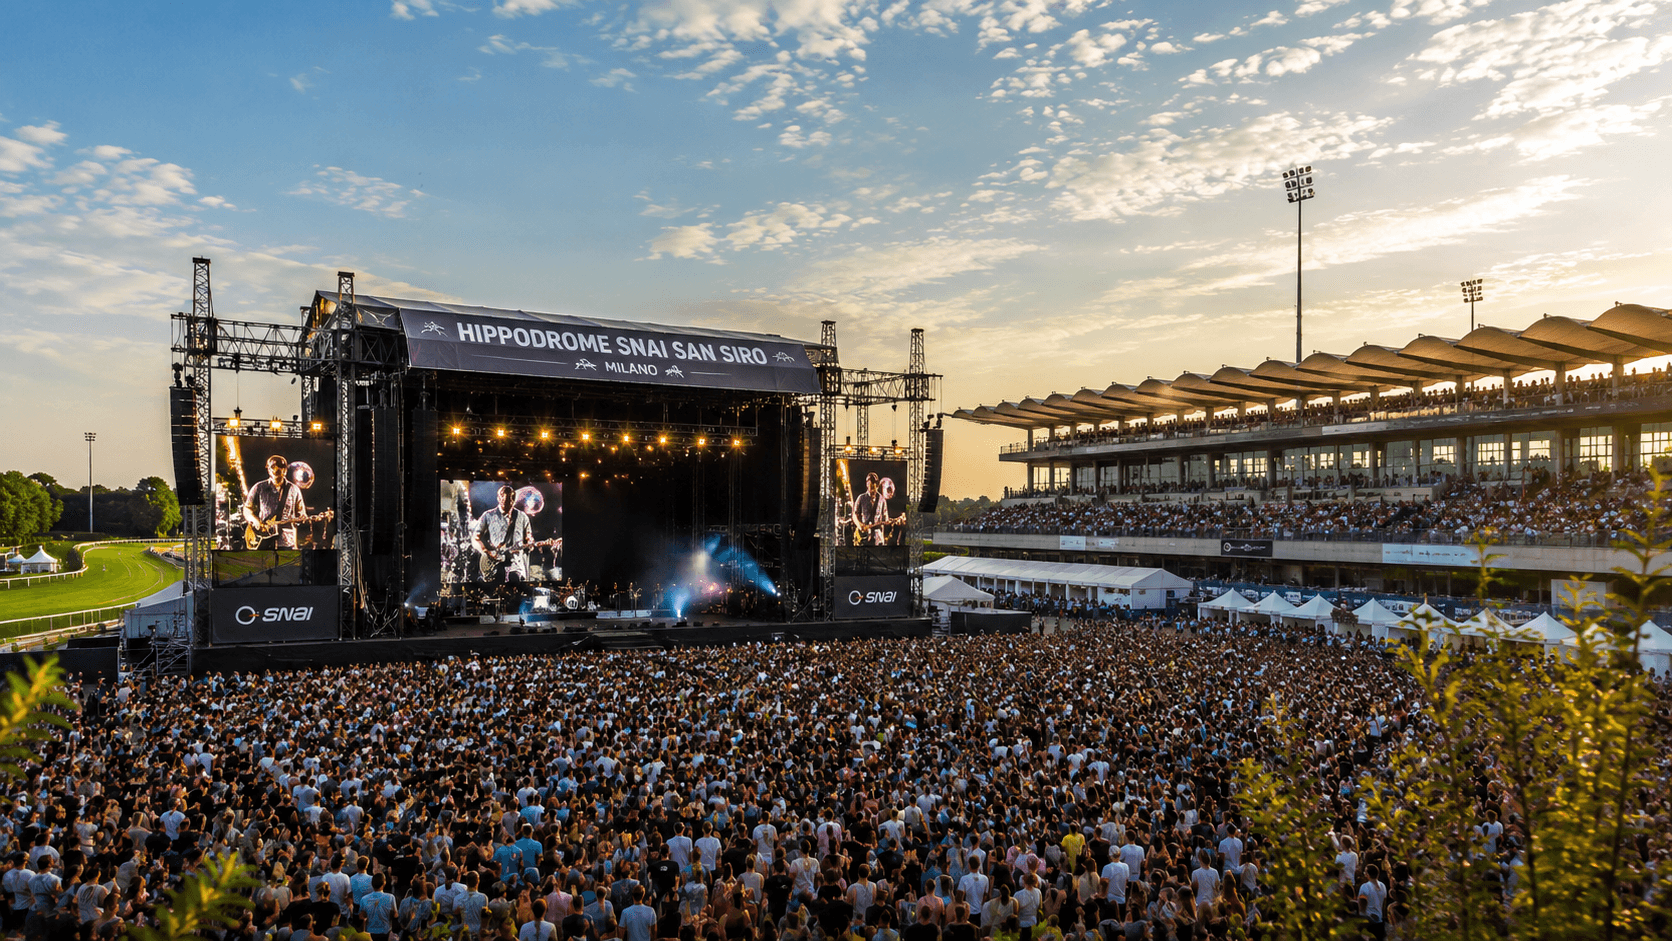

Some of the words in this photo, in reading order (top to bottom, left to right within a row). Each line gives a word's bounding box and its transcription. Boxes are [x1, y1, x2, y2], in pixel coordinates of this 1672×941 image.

[456, 322, 613, 354] HIPPODROME
[617, 337, 669, 359] SNAI
[671, 341, 718, 361] SAN
[719, 346, 768, 365] SIRO
[604, 361, 658, 376] MILANO
